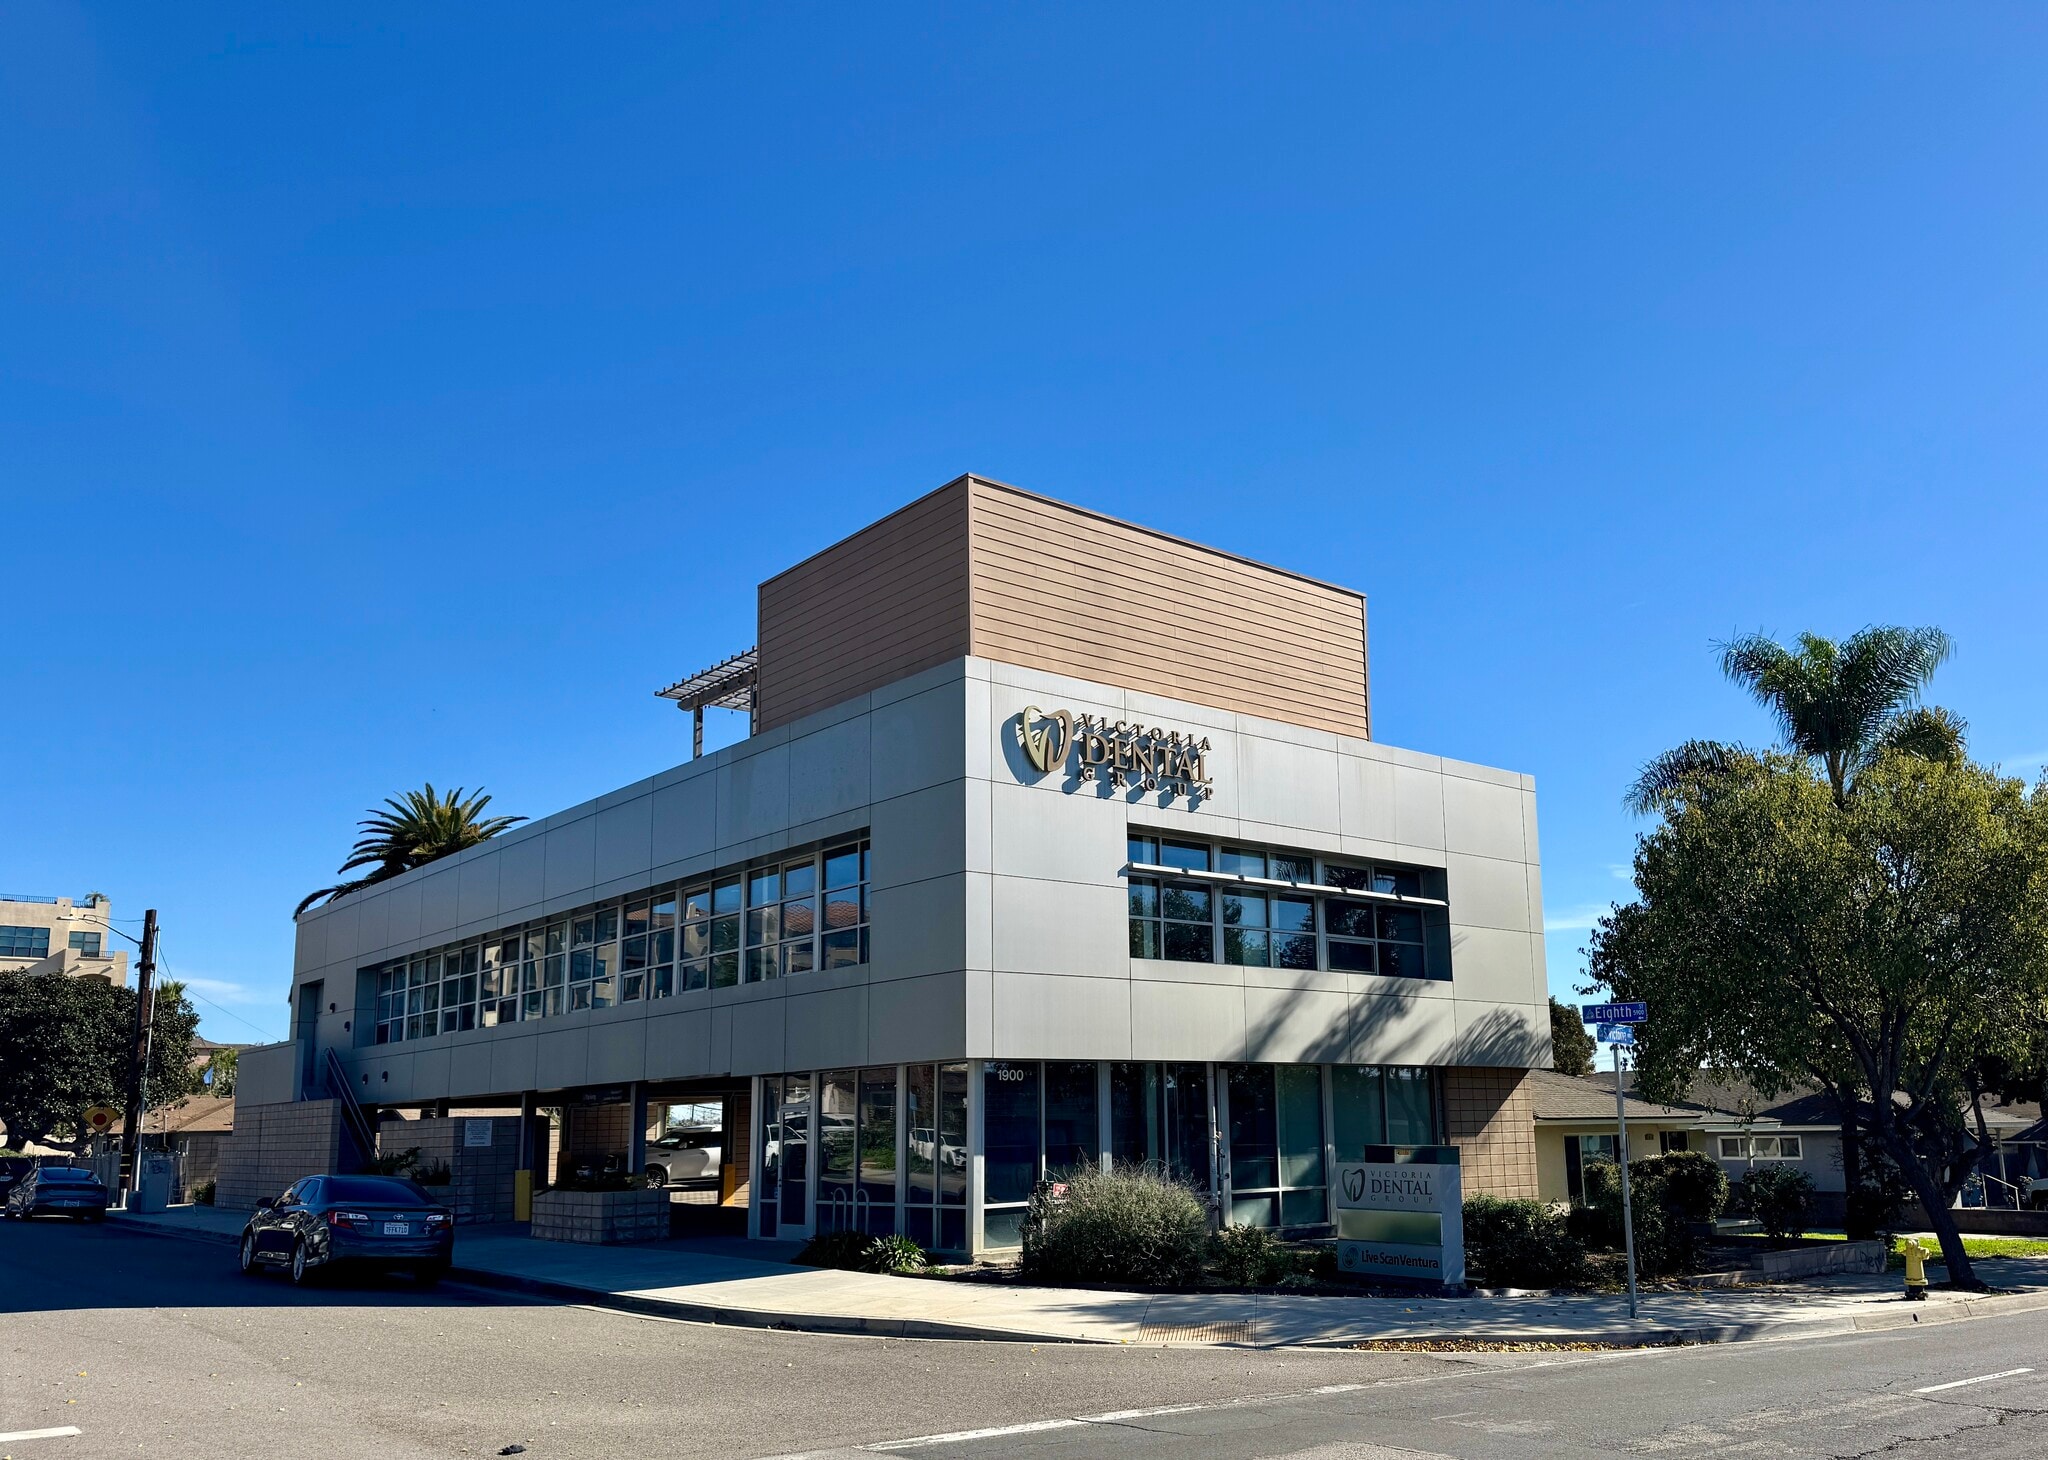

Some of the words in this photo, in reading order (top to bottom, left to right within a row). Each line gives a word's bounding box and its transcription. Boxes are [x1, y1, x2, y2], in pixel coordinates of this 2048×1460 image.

[1081, 713, 1212, 750] VICTORIA
[1083, 732, 1213, 784] DENTAL
[1083, 767, 1214, 801] GROUP
[1595, 1006, 1632, 1021] Eighth
[997, 1069, 1024, 1081] 1900
[1370, 1170, 1431, 1179] VICTORIA
[1370, 1179, 1433, 1195] DENTAL
[1370, 1195, 1433, 1204] GROUP
